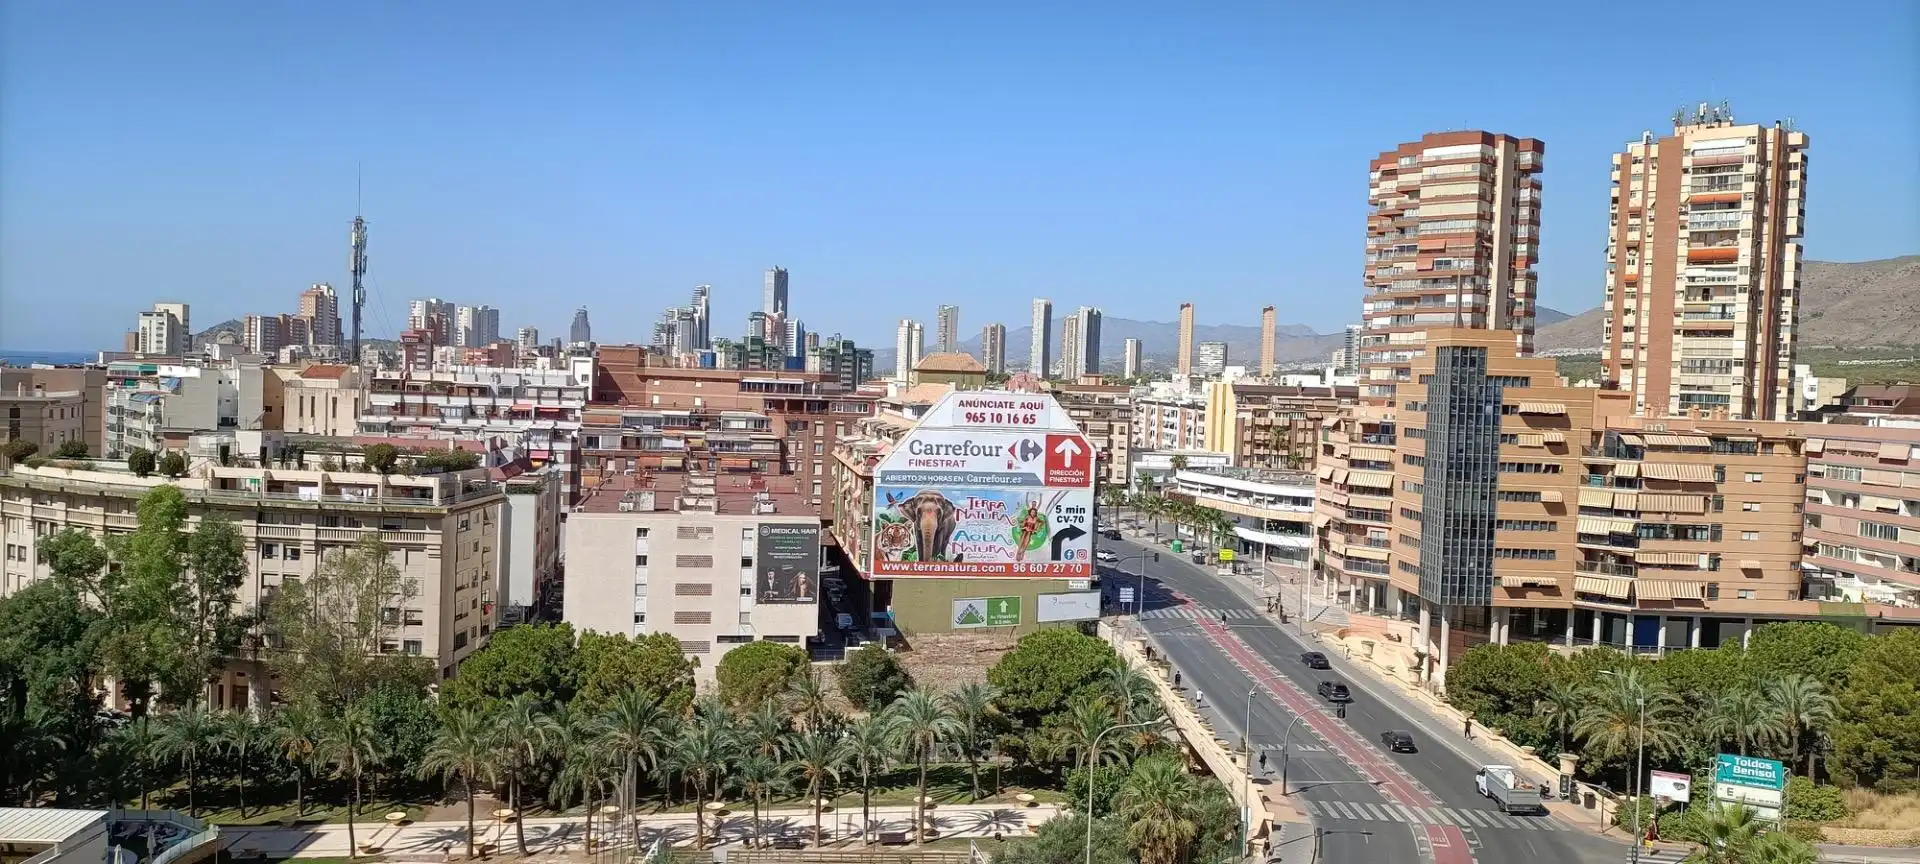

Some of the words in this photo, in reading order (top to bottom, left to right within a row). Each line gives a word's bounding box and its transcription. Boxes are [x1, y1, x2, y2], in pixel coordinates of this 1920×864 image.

[958, 398, 1015, 409] ANÚNCIATE
[1019, 401, 1044, 410] AQUÍ
[965, 412, 986, 423] 965
[990, 413, 1003, 424] 10
[1007, 413, 1020, 424] 16
[1022, 413, 1036, 424] 65
[909, 439, 1003, 457] Carrefour
[908, 459, 967, 468] FINESTRAT
[885, 474, 918, 482] ABIERTO
[966, 473, 1023, 484] Carrefour.es
[966, 496, 1007, 511] TERRA
[1055, 505, 1062, 514] 5
[1065, 505, 1086, 514] min
[955, 508, 1017, 526] NATURA
[1056, 515, 1084, 523] CV-70
[953, 530, 1015, 546] AQUA
[952, 542, 1016, 559] NATURA
[881, 563, 1006, 574] www.terranatura.com
[1013, 563, 1026, 573] 96
[1029, 563, 1048, 573] 607
[1053, 563, 1065, 573] 27
[1069, 563, 1082, 573] 70
[954, 607, 969, 624] LEROY
[1734, 757, 1772, 770] Toldos
[1732, 765, 1776, 779] Benisol
[1726, 787, 1734, 796] E
